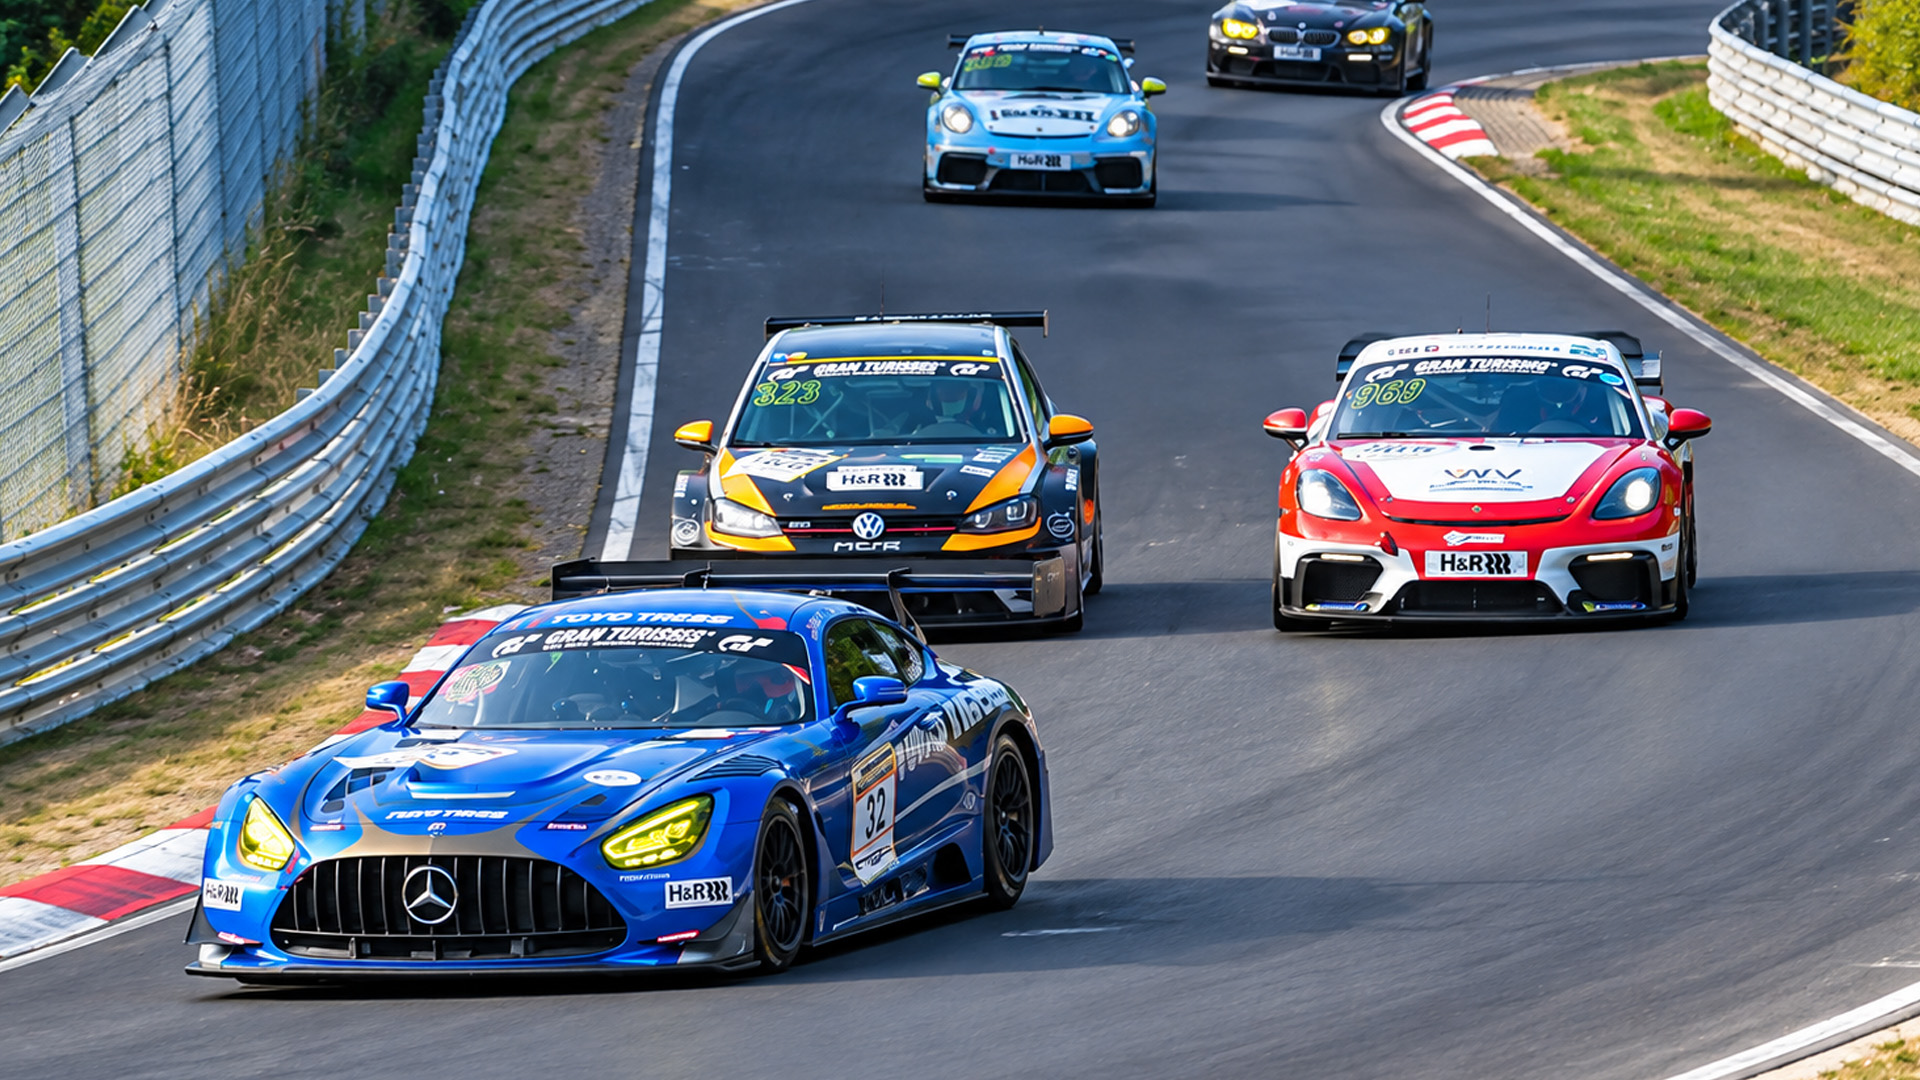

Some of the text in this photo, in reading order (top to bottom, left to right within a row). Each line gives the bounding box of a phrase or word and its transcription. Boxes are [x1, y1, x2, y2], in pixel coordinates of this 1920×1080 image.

[812, 362, 861, 375] GRAN
[1413, 358, 1466, 375] GRAN
[753, 379, 822, 407] 323
[1350, 378, 1427, 410] 969
[842, 473, 881, 486] H&R
[1440, 554, 1483, 573] H&R
[551, 612, 633, 625] TOYO
[545, 627, 609, 645] GRAN
[865, 787, 886, 841] 32
[669, 880, 706, 903] H&R
